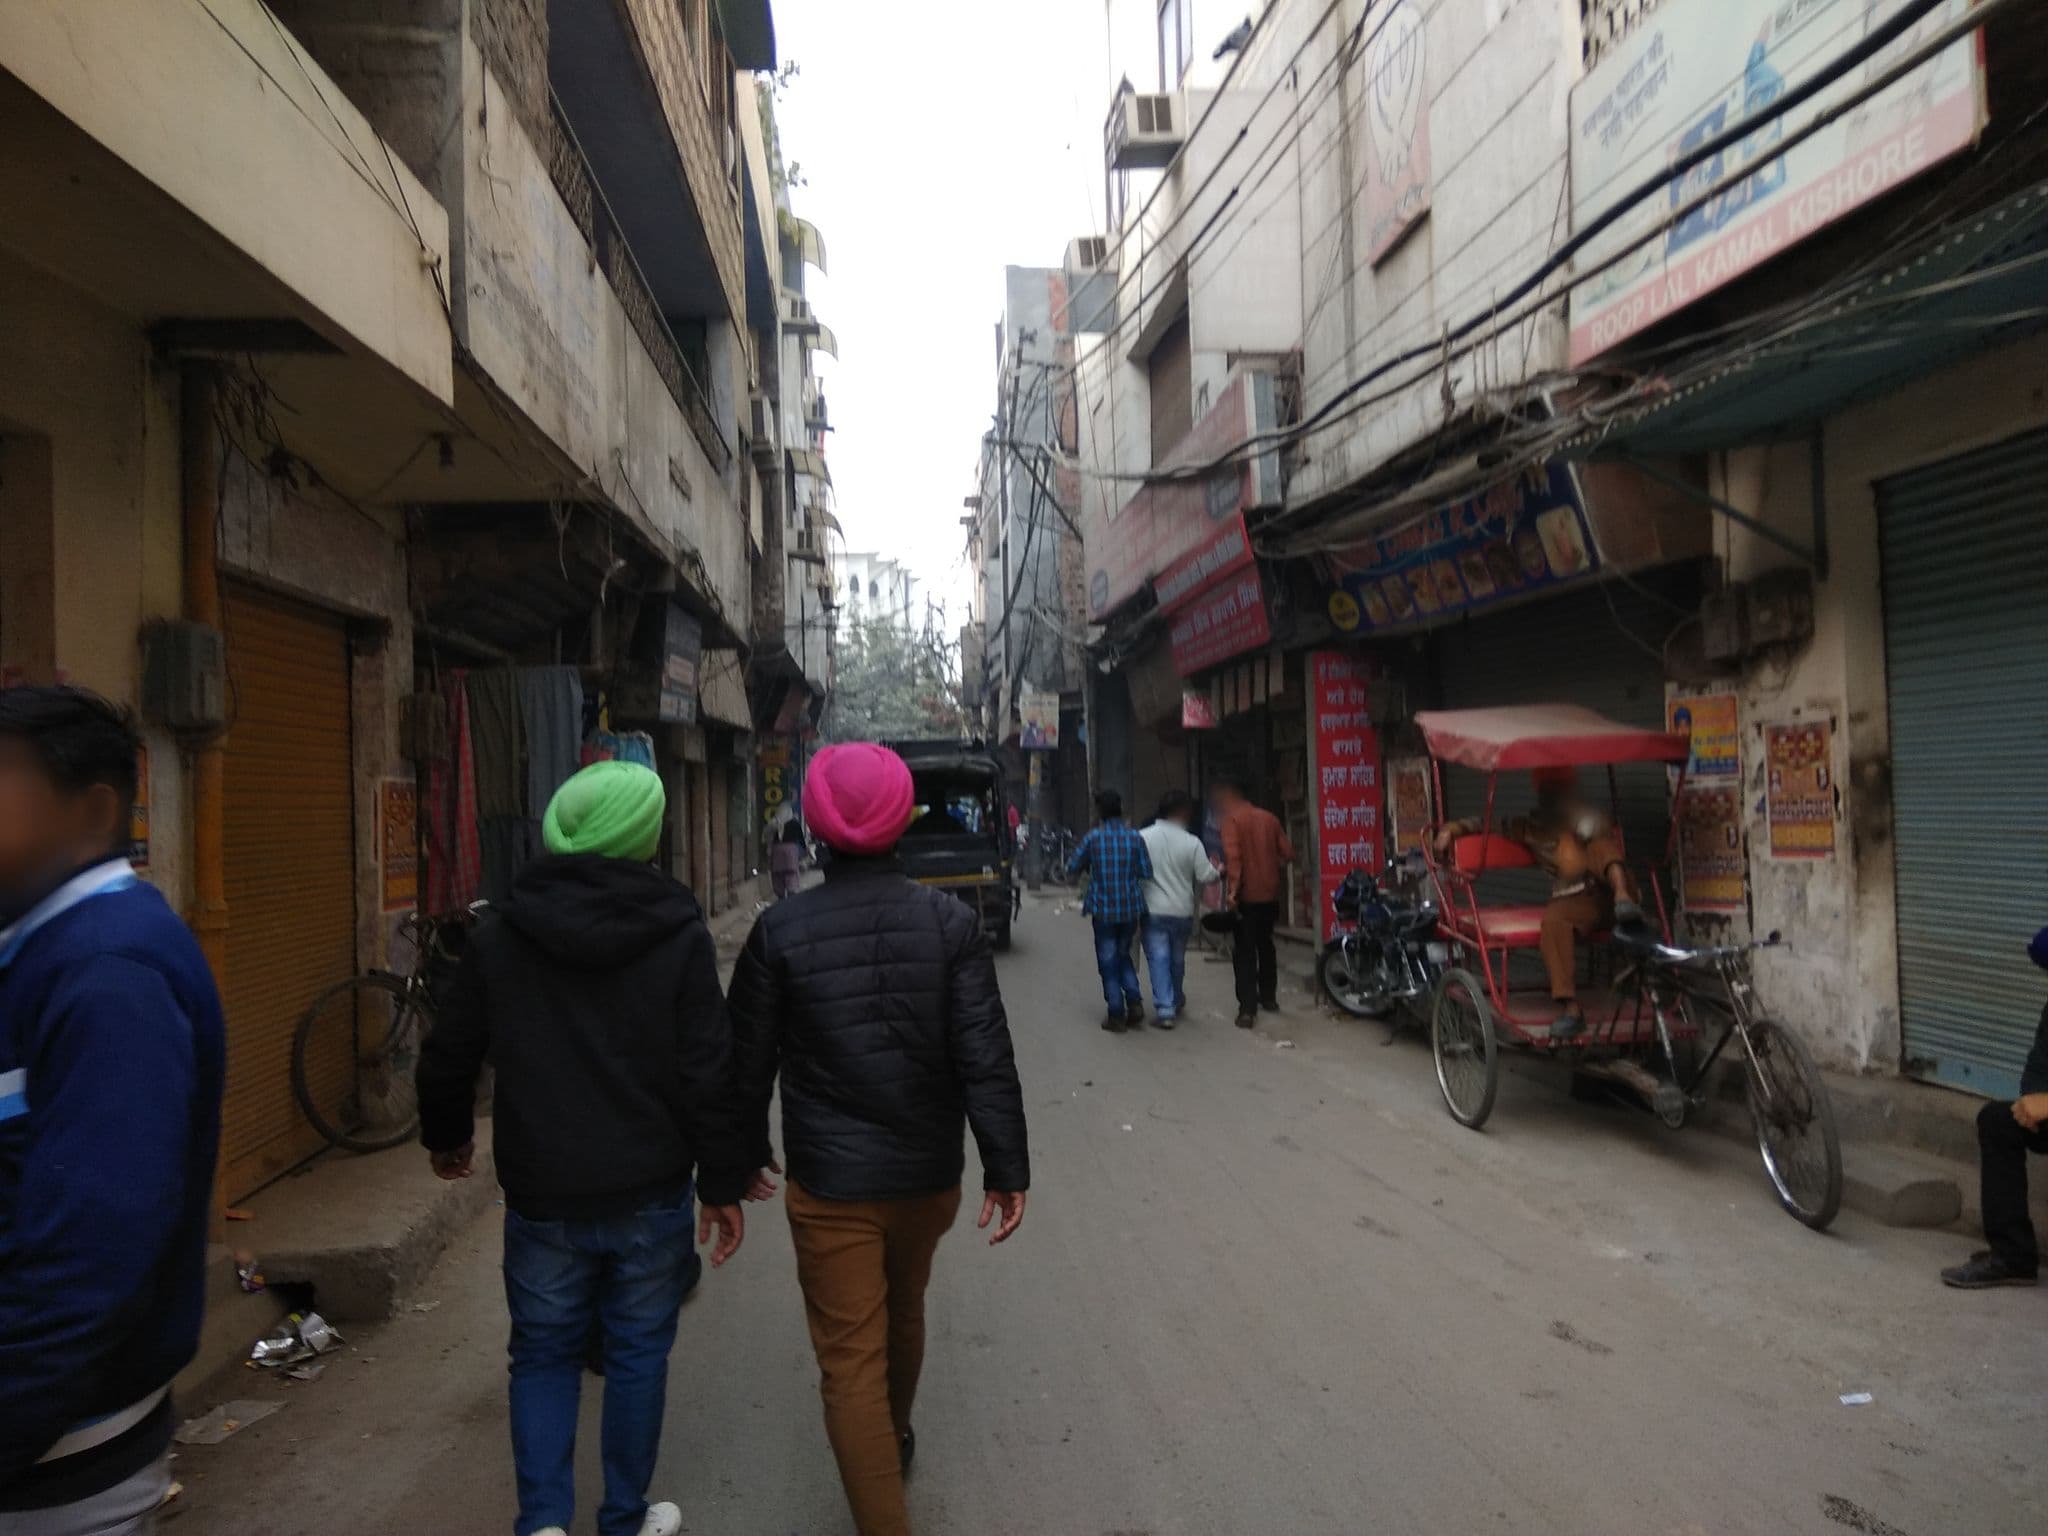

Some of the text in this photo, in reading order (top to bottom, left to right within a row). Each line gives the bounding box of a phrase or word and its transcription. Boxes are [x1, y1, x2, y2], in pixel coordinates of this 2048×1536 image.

[1591, 296, 1645, 349] ROOP
[1651, 271, 1690, 317] LAL
[1695, 216, 1782, 289] KAMAL
[1789, 123, 1927, 237] KISHORE
